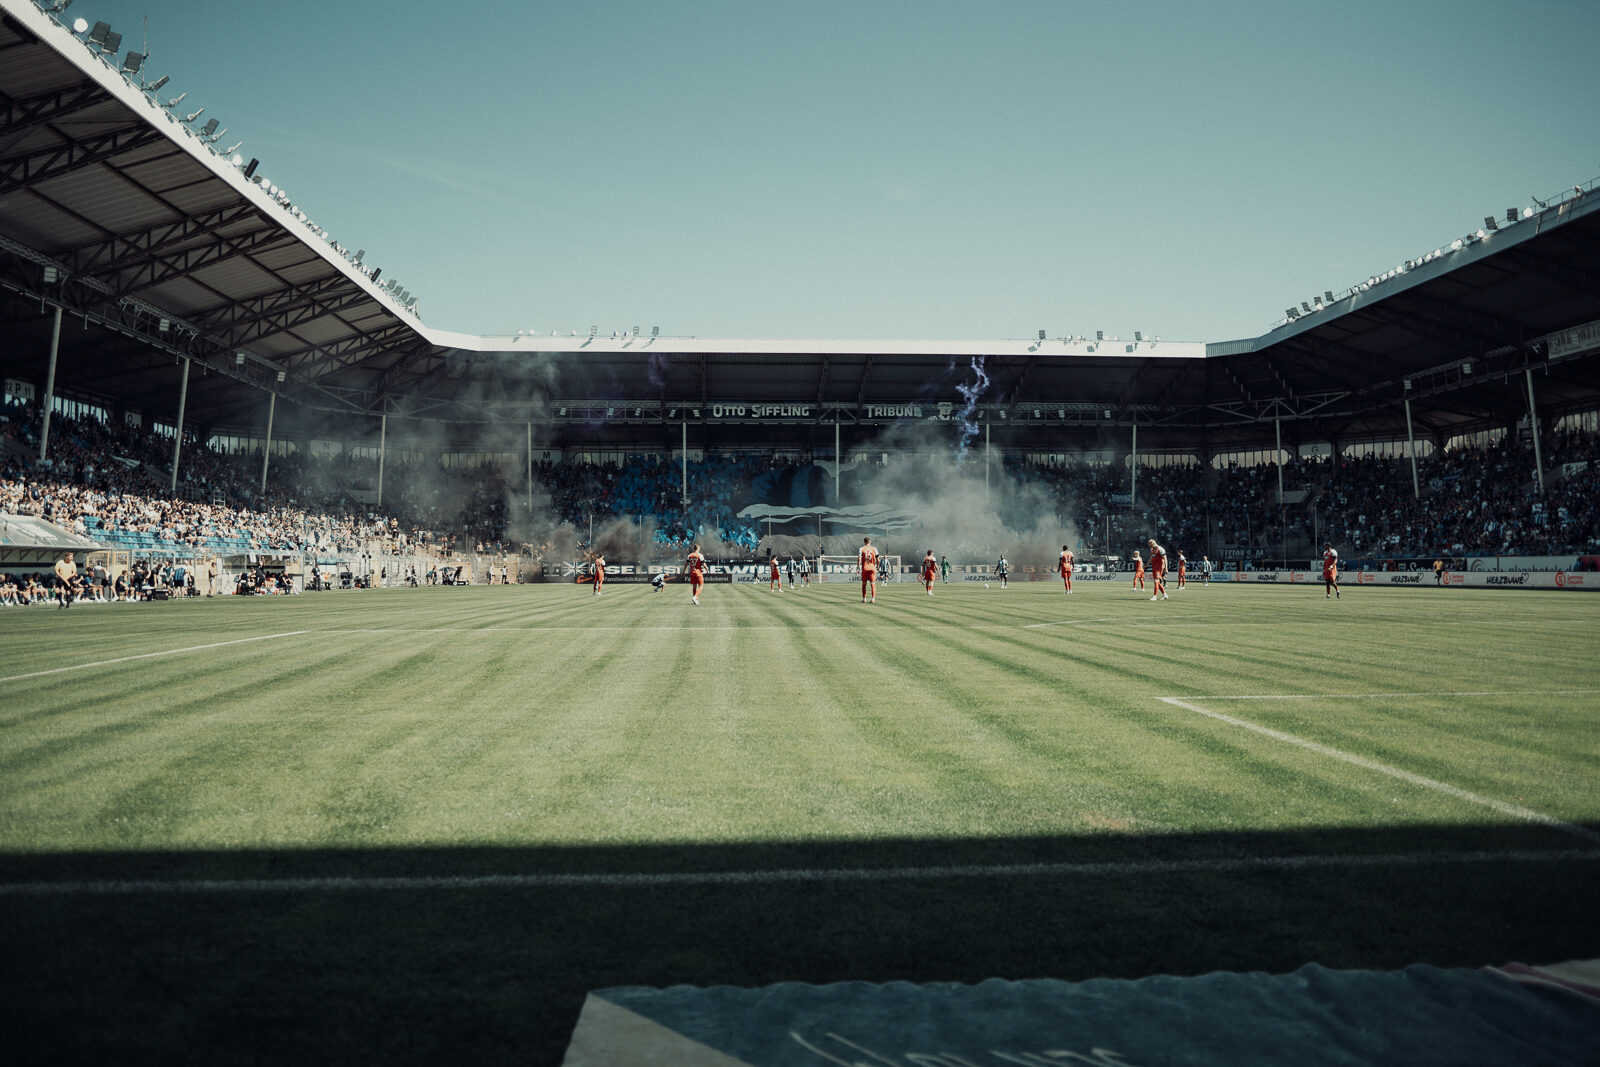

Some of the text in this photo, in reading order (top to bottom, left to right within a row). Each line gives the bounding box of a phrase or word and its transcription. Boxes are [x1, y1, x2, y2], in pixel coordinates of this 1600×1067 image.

[15, 383, 22, 394] P
[712, 404, 810, 418] OTTO SIFFLING
[542, 451, 551, 459] M
